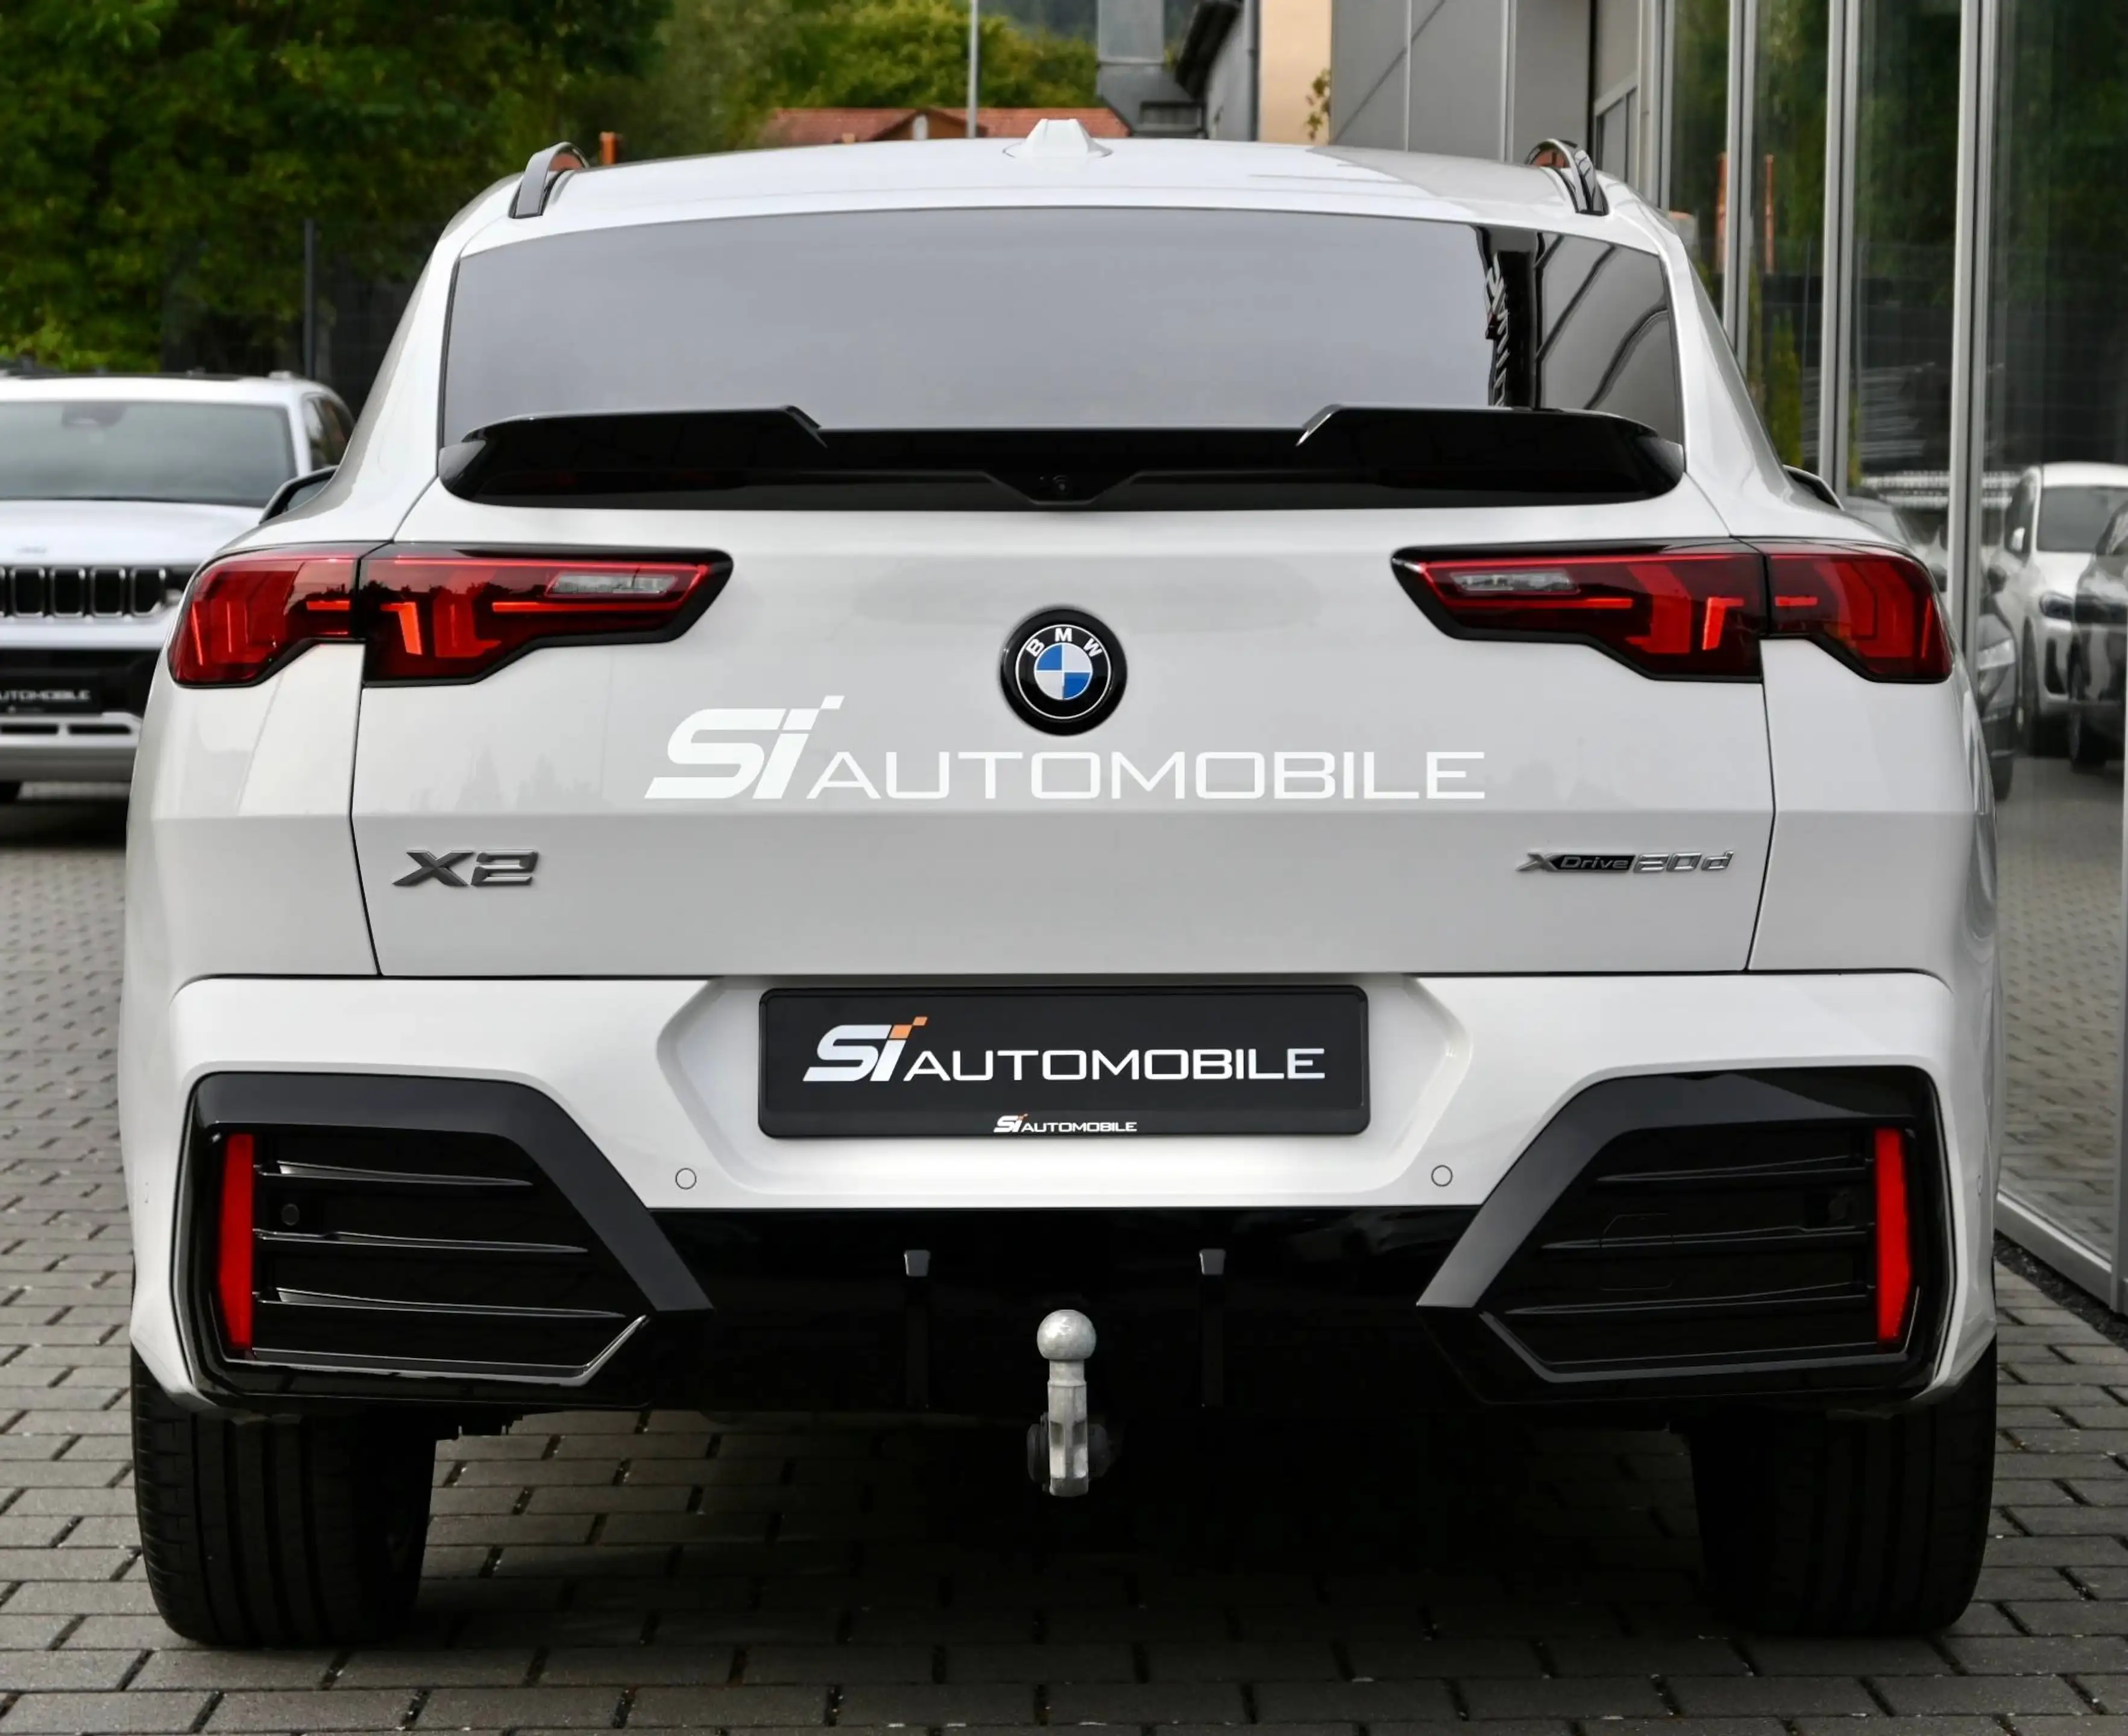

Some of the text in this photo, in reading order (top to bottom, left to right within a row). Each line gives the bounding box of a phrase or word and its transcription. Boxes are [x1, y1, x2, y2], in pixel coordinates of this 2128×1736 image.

[1025, 627, 1103, 658] BMW
[807, 751, 1485, 799] AUTOMOBILE
[392, 849, 540, 887] X2
[903, 1048, 1326, 1082] AUTOMOBILE
[1021, 1121, 1138, 1133] AUTOMOBILE
